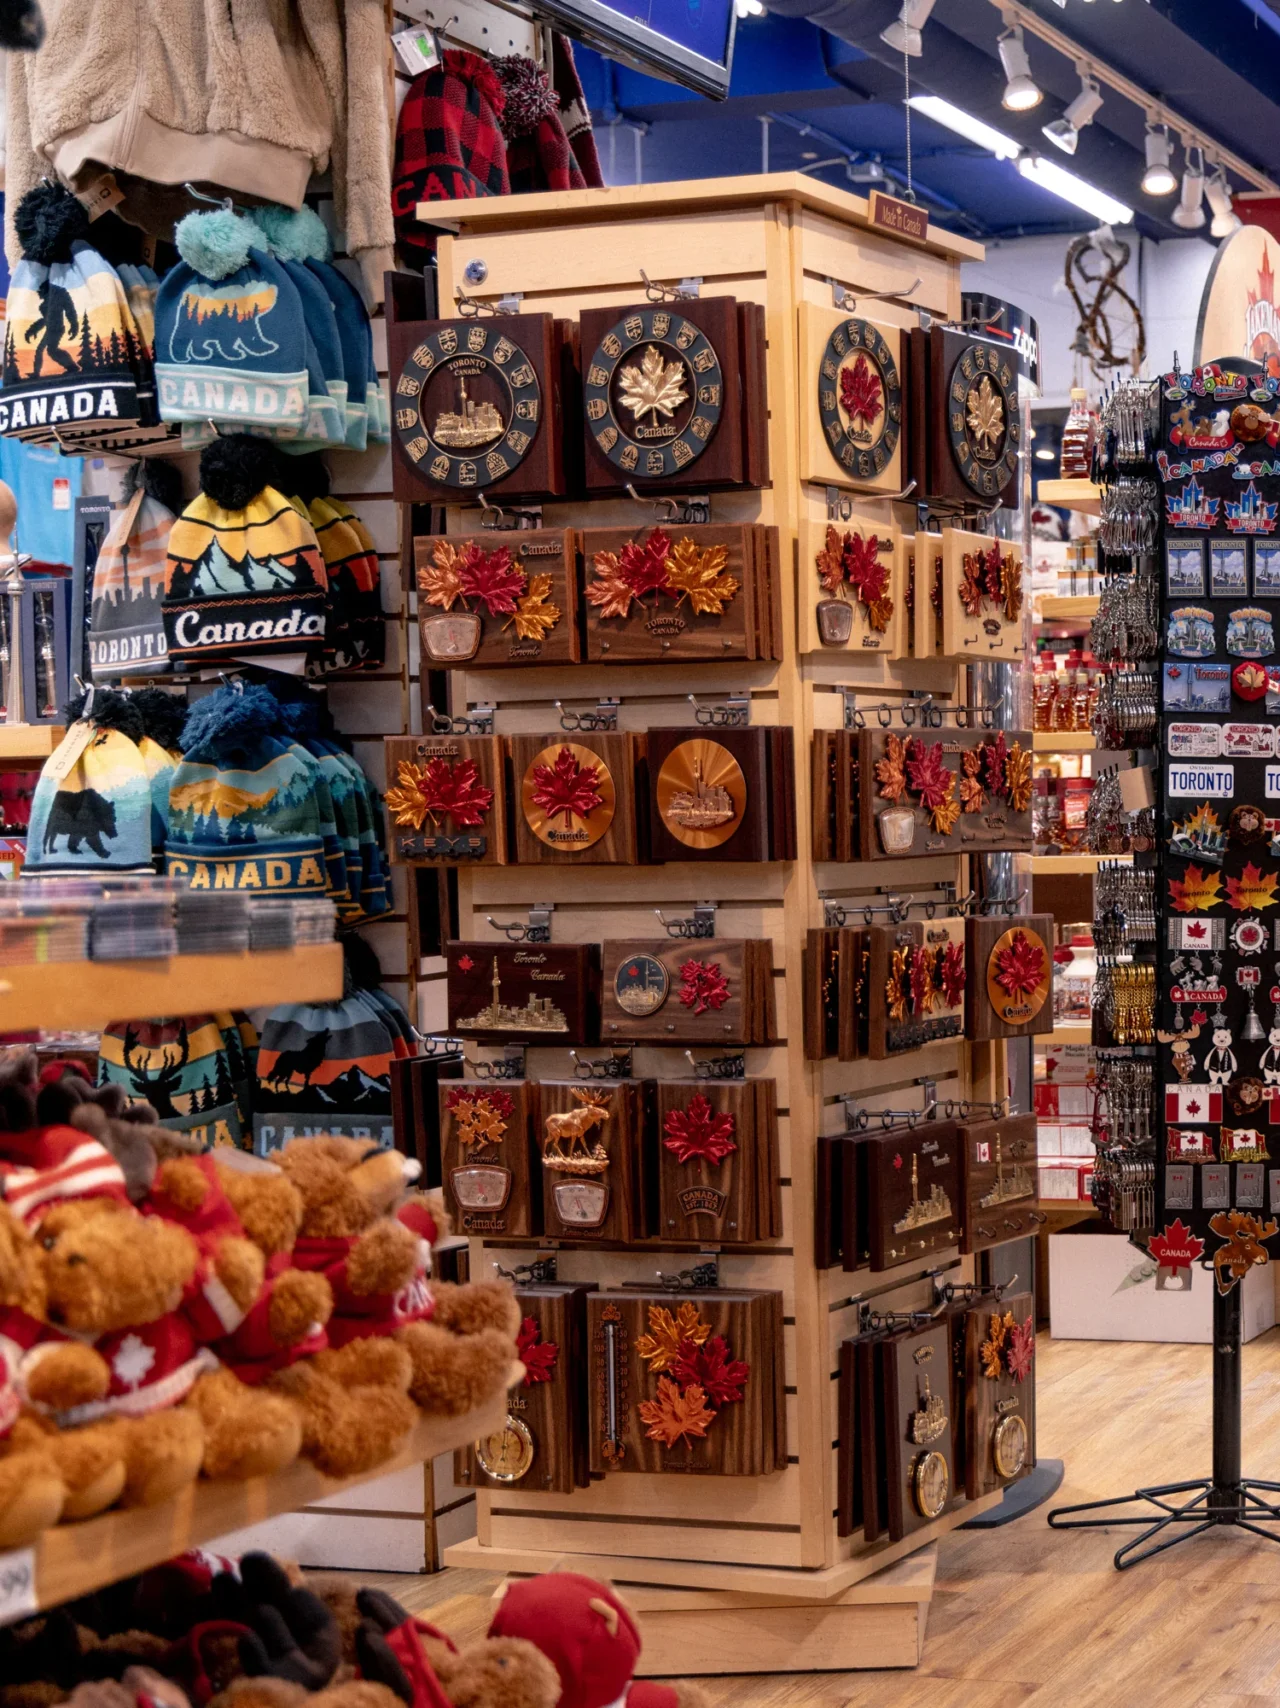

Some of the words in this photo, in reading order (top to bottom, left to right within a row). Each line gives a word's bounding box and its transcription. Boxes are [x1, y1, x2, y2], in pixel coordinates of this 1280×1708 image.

[391, 172, 488, 217] CAN
[881, 206, 897, 226] Made
[896, 216, 903, 230] in
[902, 214, 921, 235] Canada
[447, 358, 487, 370] TORONTO
[1164, 366, 1247, 397] TORONTO
[160, 377, 303, 415] CANADA
[0, 389, 119, 429] CANADA
[635, 425, 676, 439] Canada
[1189, 437, 1220, 448] Canada
[1168, 450, 1238, 478] CANADA
[1179, 514, 1206, 522] TORONTO
[1239, 520, 1265, 528] TORONTO
[520, 541, 562, 556] Canada
[175, 608, 326, 647] Canada
[645, 617, 686, 629] TORONTO
[652, 627, 679, 635] CANADA
[90, 632, 168, 664] TORONTO
[1195, 668, 1228, 680] Toronto
[417, 744, 458, 756] Canada
[1171, 772, 1232, 791] TORONTO
[548, 829, 589, 842] Canada
[401, 838, 482, 847] KEYS
[168, 857, 323, 888] CANADA
[1179, 890, 1210, 898] Toronto
[1236, 886, 1267, 894] Toronto
[514, 952, 547, 963] Toronto
[531, 969, 566, 981] Canada
[1190, 992, 1223, 1000] CANADA
[922, 1016, 961, 1030] KEYS
[1166, 1085, 1222, 1094] CANADA
[683, 1191, 718, 1202] CANADA
[463, 1215, 505, 1230] Canada
[1160, 1249, 1191, 1258] CANADA
[1218, 1256, 1246, 1265] Canada
